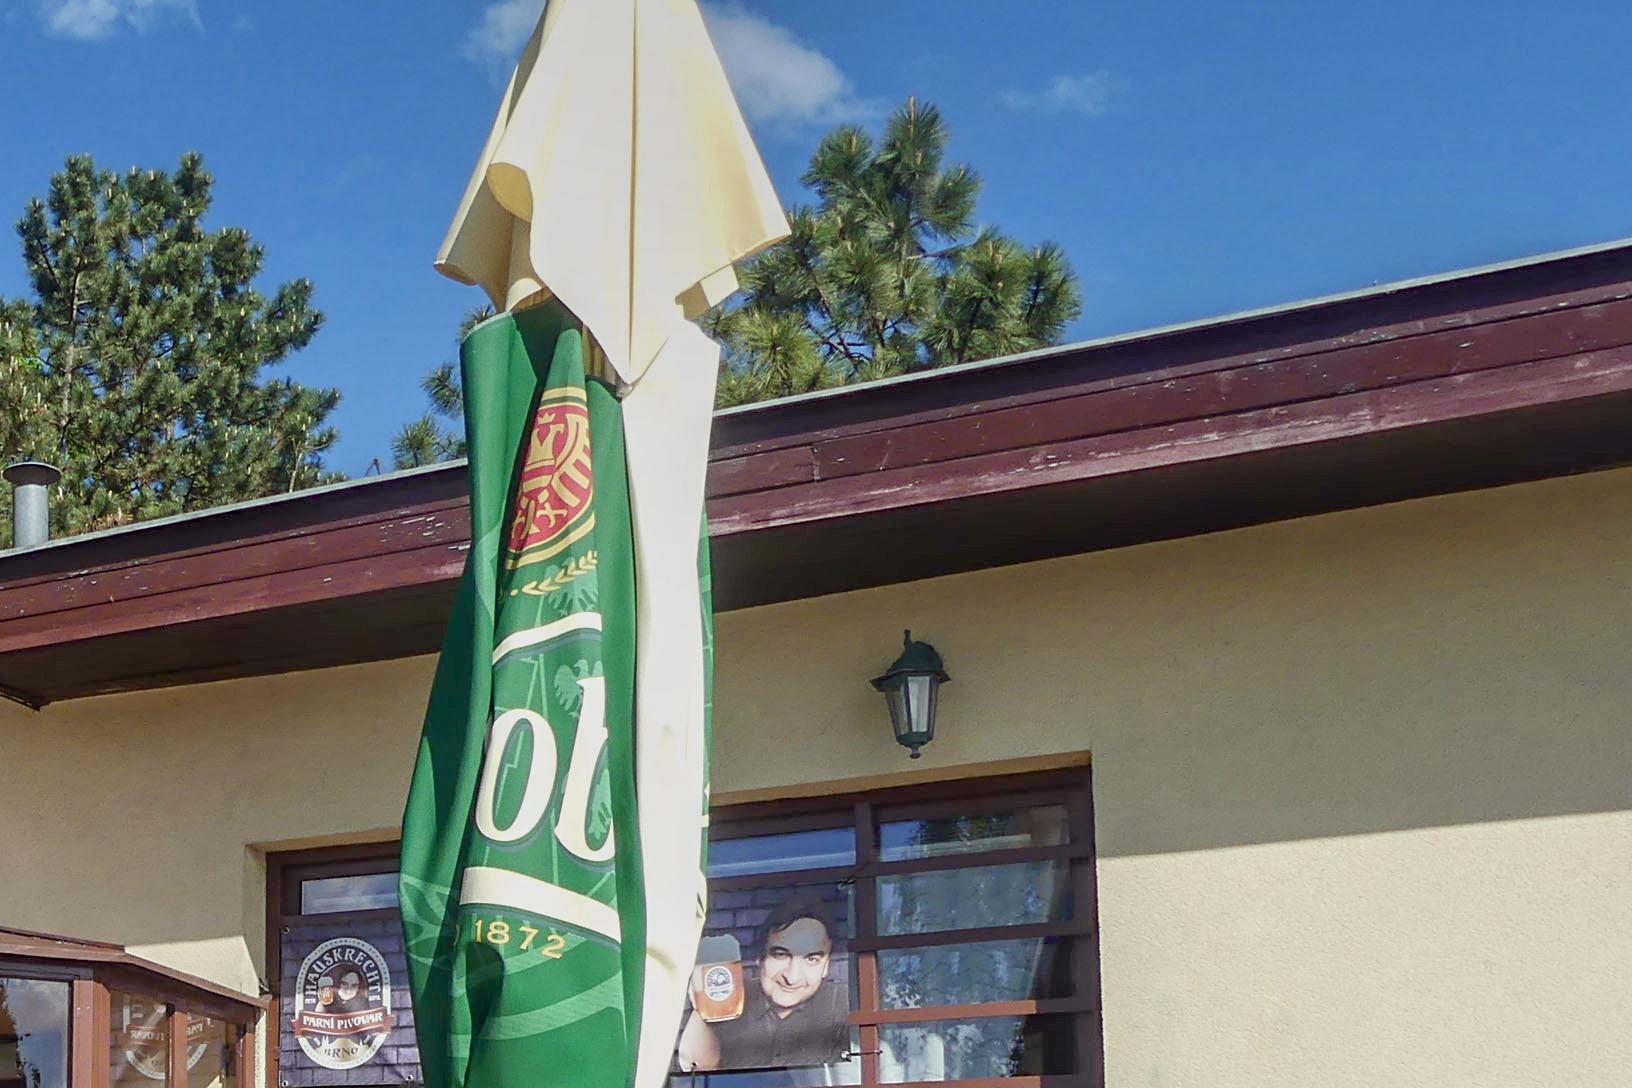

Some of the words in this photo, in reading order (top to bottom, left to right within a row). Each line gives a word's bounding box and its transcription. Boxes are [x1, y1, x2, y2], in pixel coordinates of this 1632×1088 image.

[474, 919, 566, 959] 1872
[305, 948, 381, 996] HAUSKRECHT
[302, 1014, 334, 1029] PARNÍ
[337, 1012, 383, 1029] PIVOVAR
